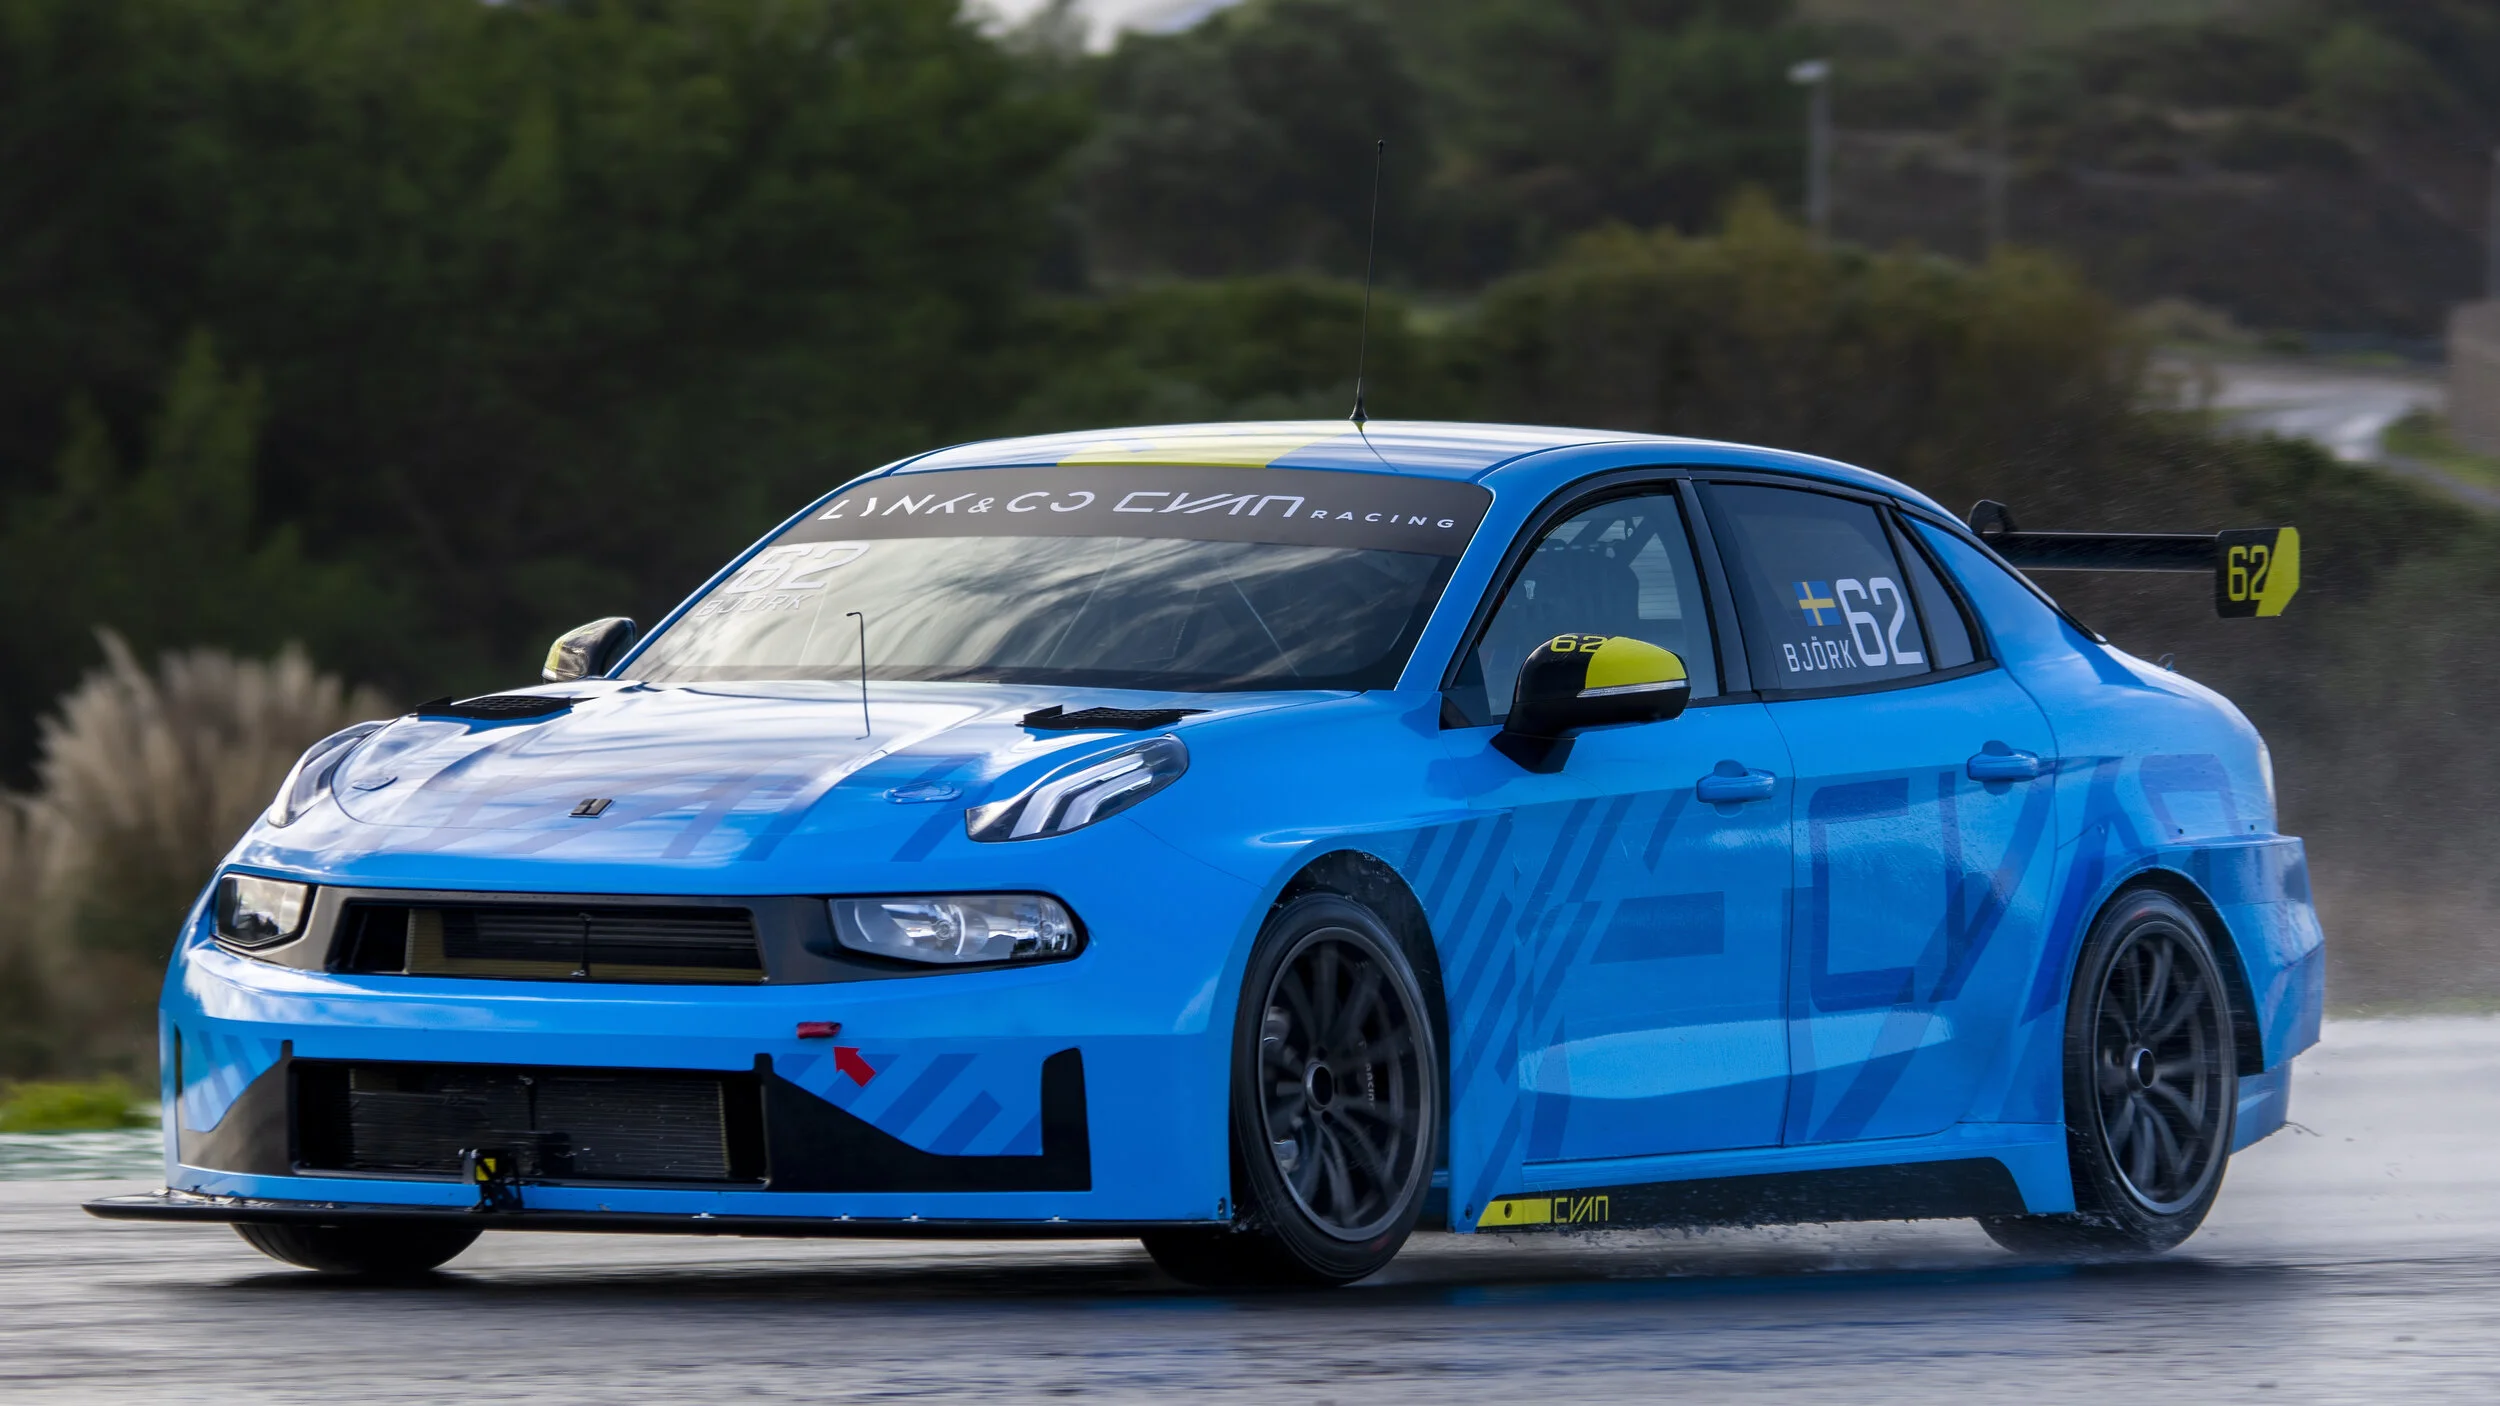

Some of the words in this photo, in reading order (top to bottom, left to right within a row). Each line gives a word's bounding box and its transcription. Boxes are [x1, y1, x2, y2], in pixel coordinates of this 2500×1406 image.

[1310, 508, 1455, 529] RACING
[723, 542, 870, 595] 62
[2227, 544, 2270, 602] 62
[1549, 634, 1608, 653] 62
[1835, 576, 1925, 667] 62
[1783, 635, 1857, 673] BJÖRK
